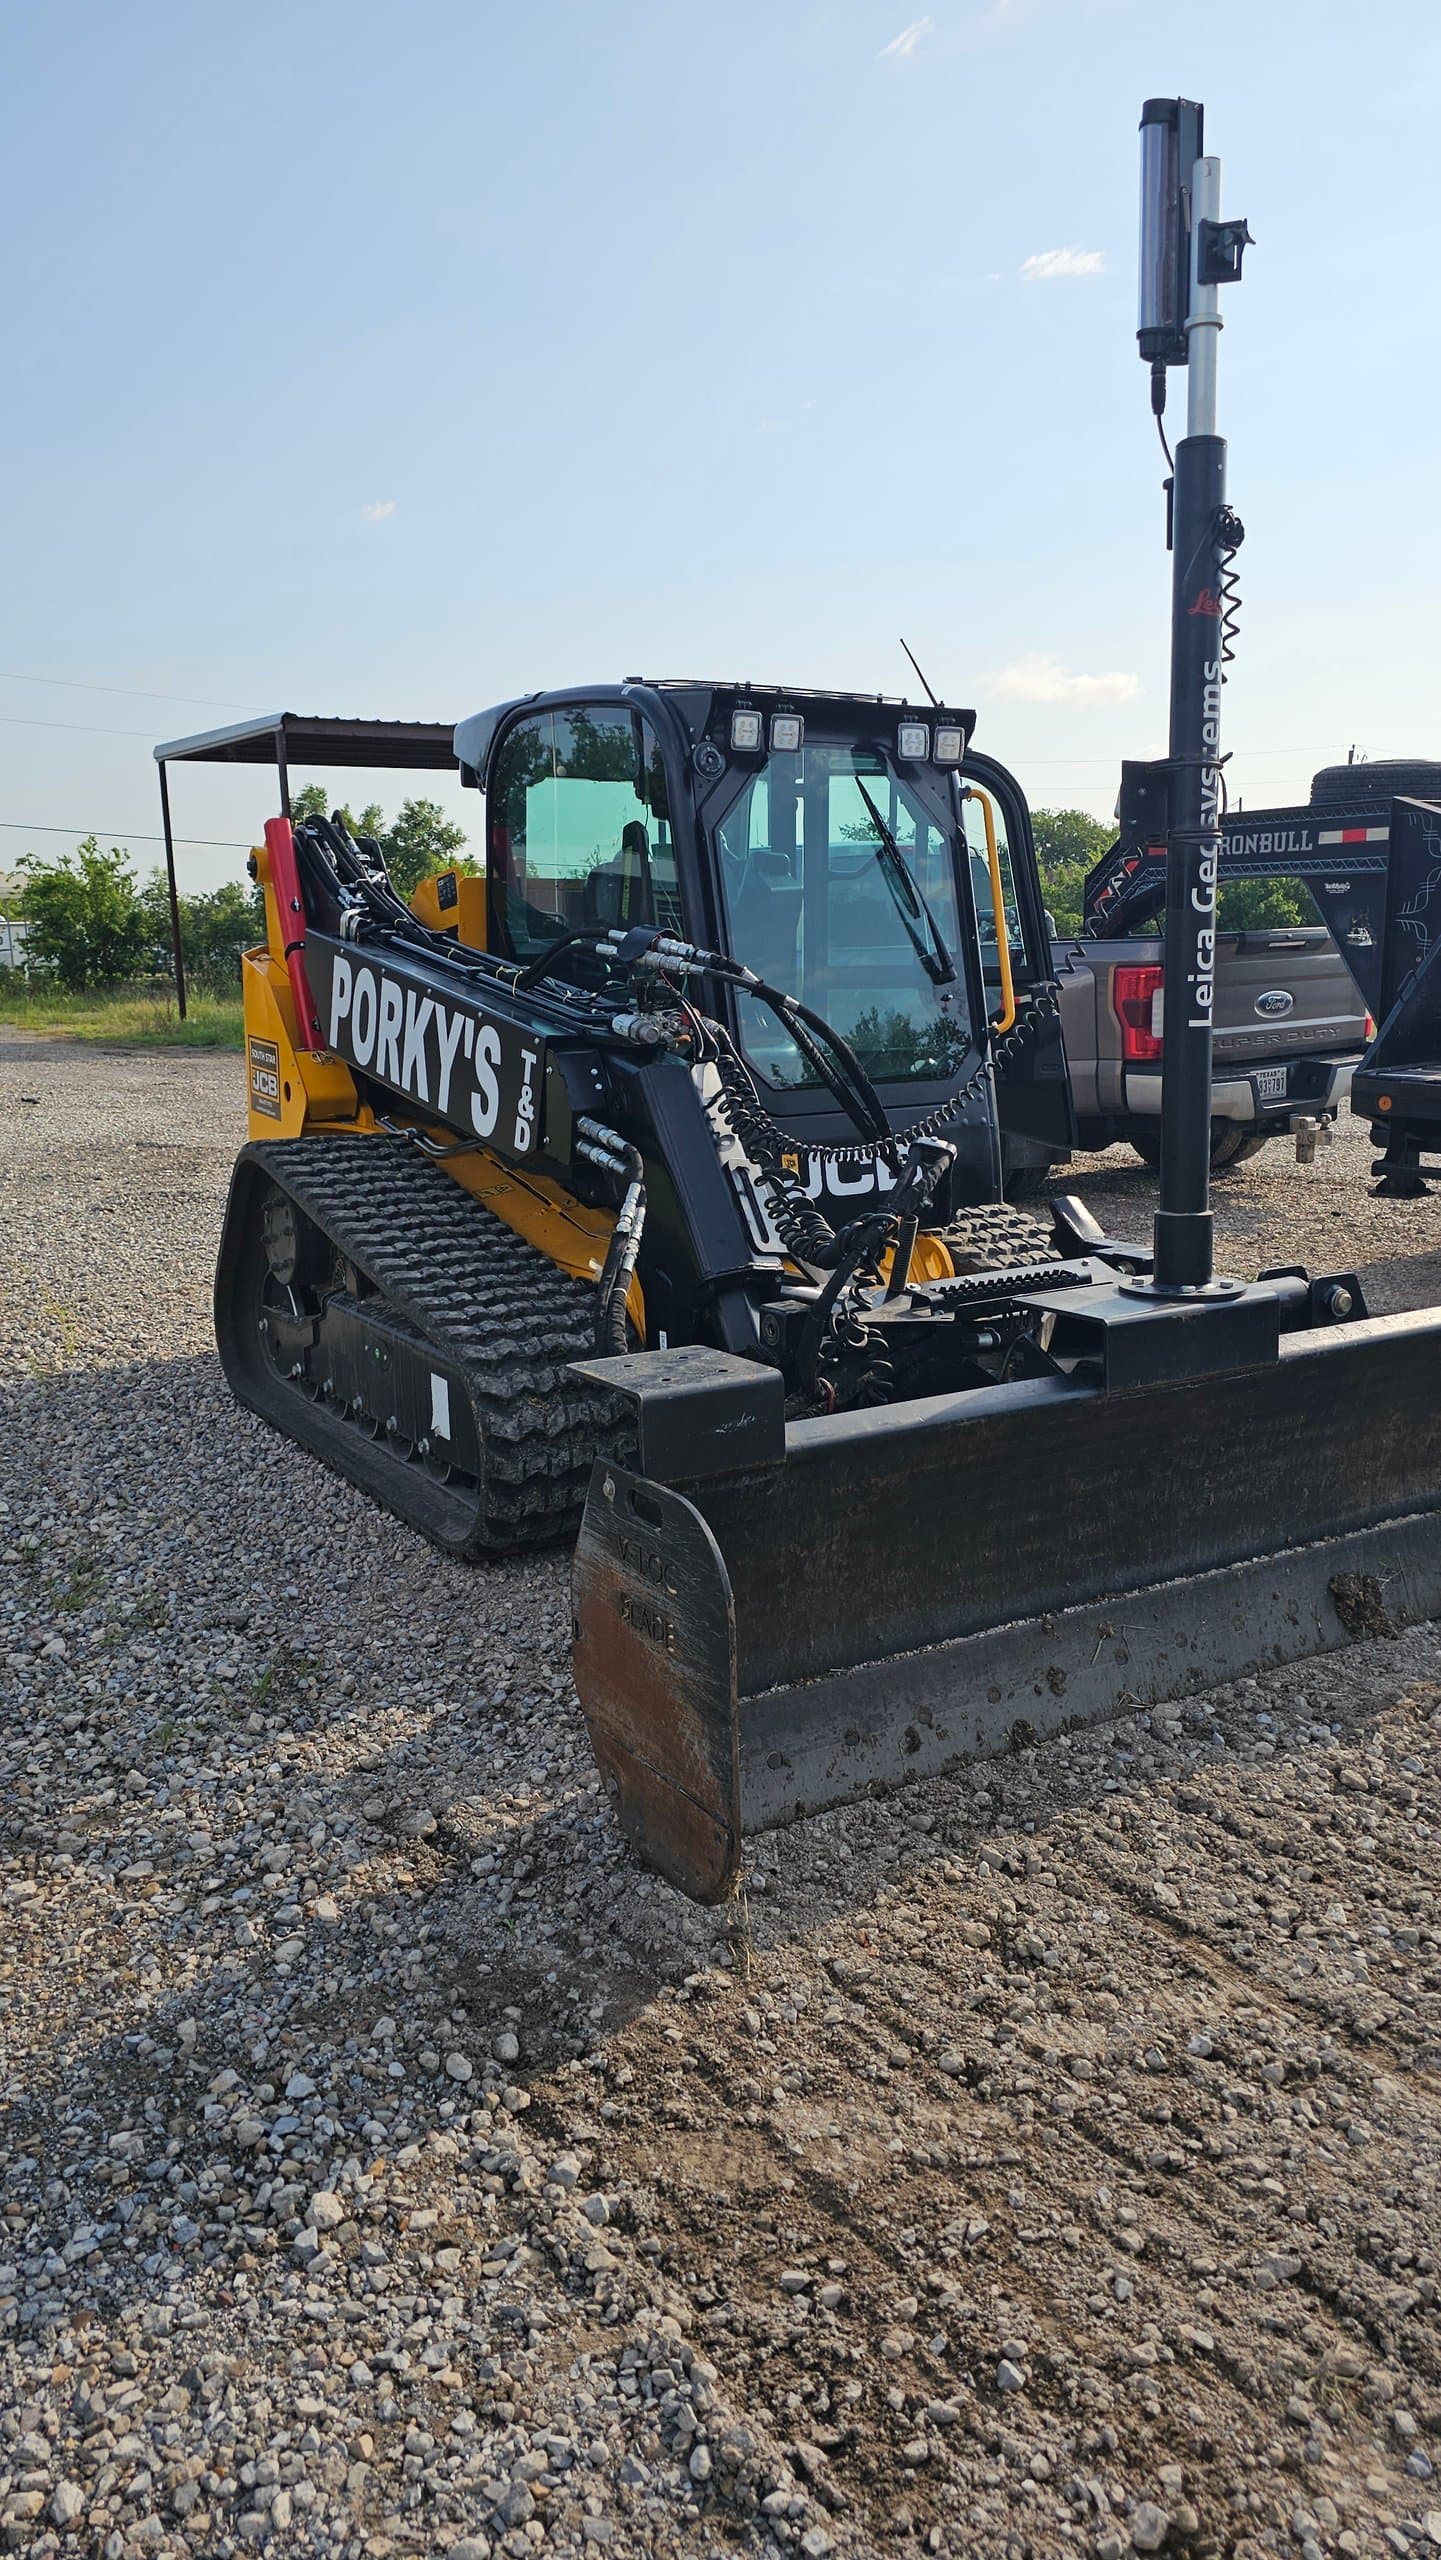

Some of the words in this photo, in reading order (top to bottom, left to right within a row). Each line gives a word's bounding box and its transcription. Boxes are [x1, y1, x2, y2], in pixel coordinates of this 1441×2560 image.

[1219, 830, 1313, 856] RONBULL
[1187, 928, 1215, 1028] Leica
[1265, 996, 1287, 1010] Ford
[329, 955, 501, 1138] PORKY'S
[1212, 1034, 1281, 1049] UPER
[1287, 1026, 1341, 1042] DUTY
[252, 1070, 277, 1097] JCB
[1259, 1070, 1277, 1078] TEXAS
